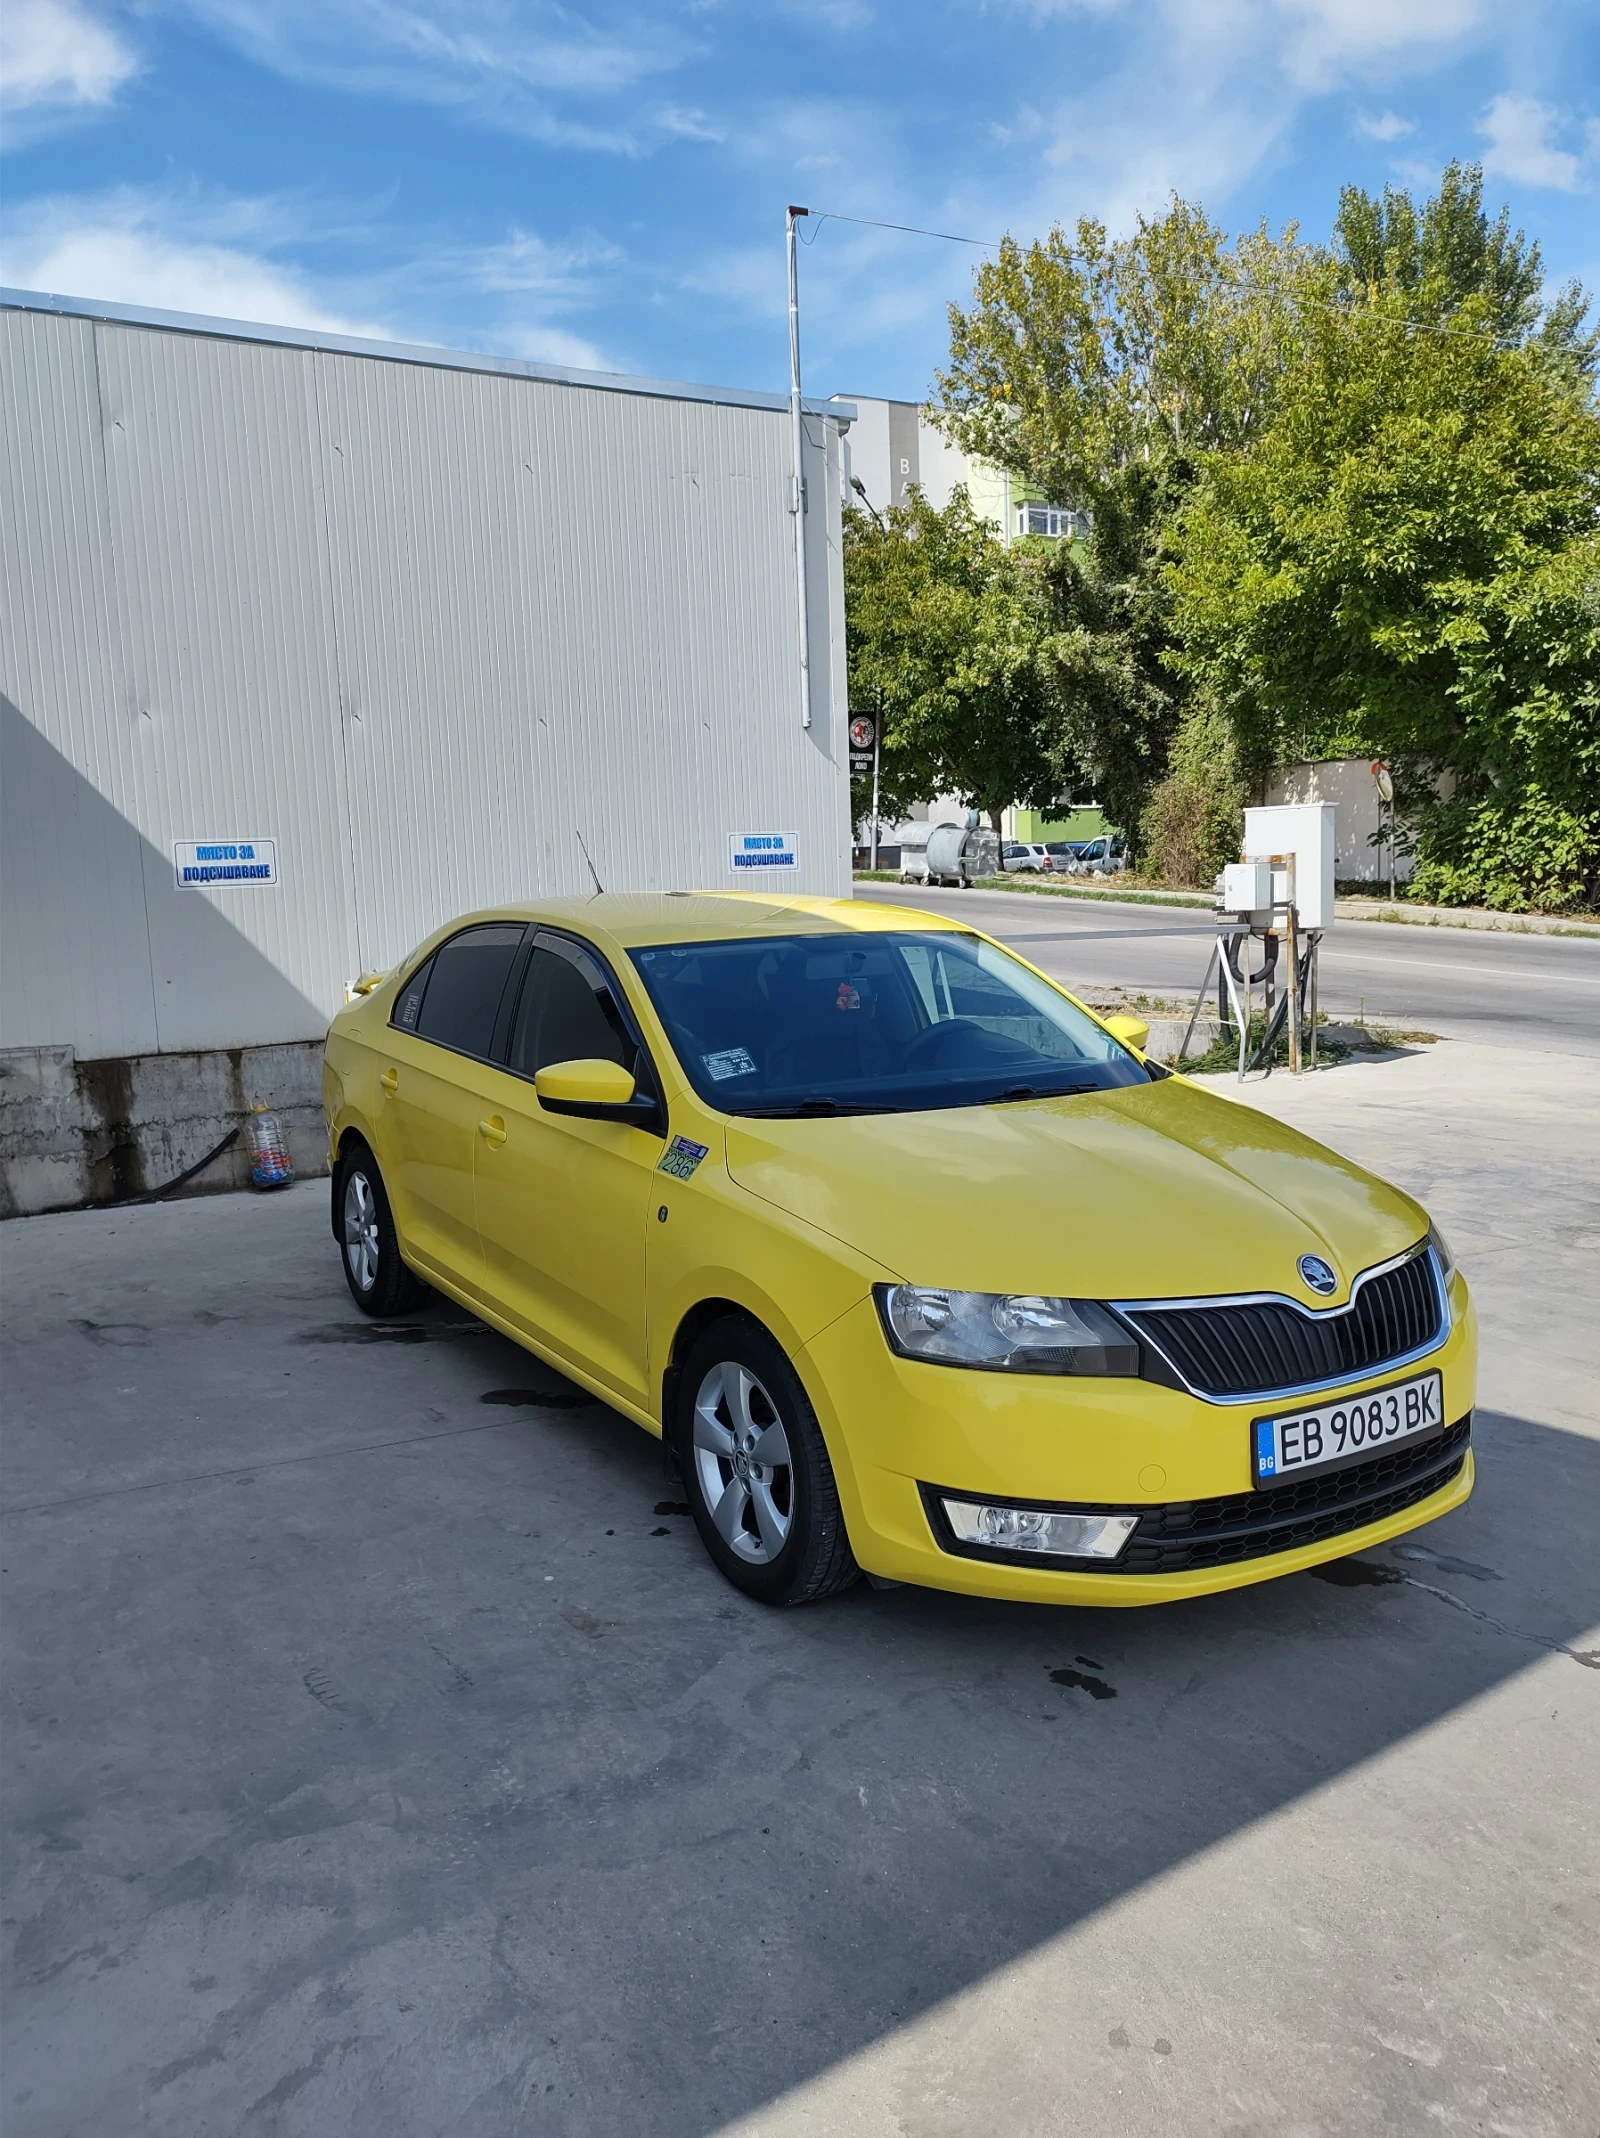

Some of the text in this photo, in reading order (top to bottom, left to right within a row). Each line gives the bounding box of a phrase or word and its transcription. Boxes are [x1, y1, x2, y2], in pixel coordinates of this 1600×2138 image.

[744, 836, 784, 850] МЯСТО ЗА
[196, 845, 255, 861] МЯСТО ЗА
[734, 853, 794, 868] ПОДСУШАВАНЕ
[183, 864, 271, 883] ПОДСУШАВАНЕ
[661, 1153, 694, 1178] 286
[1330, 1395, 1400, 1453] 9083
[1259, 1456, 1274, 1471] BG
